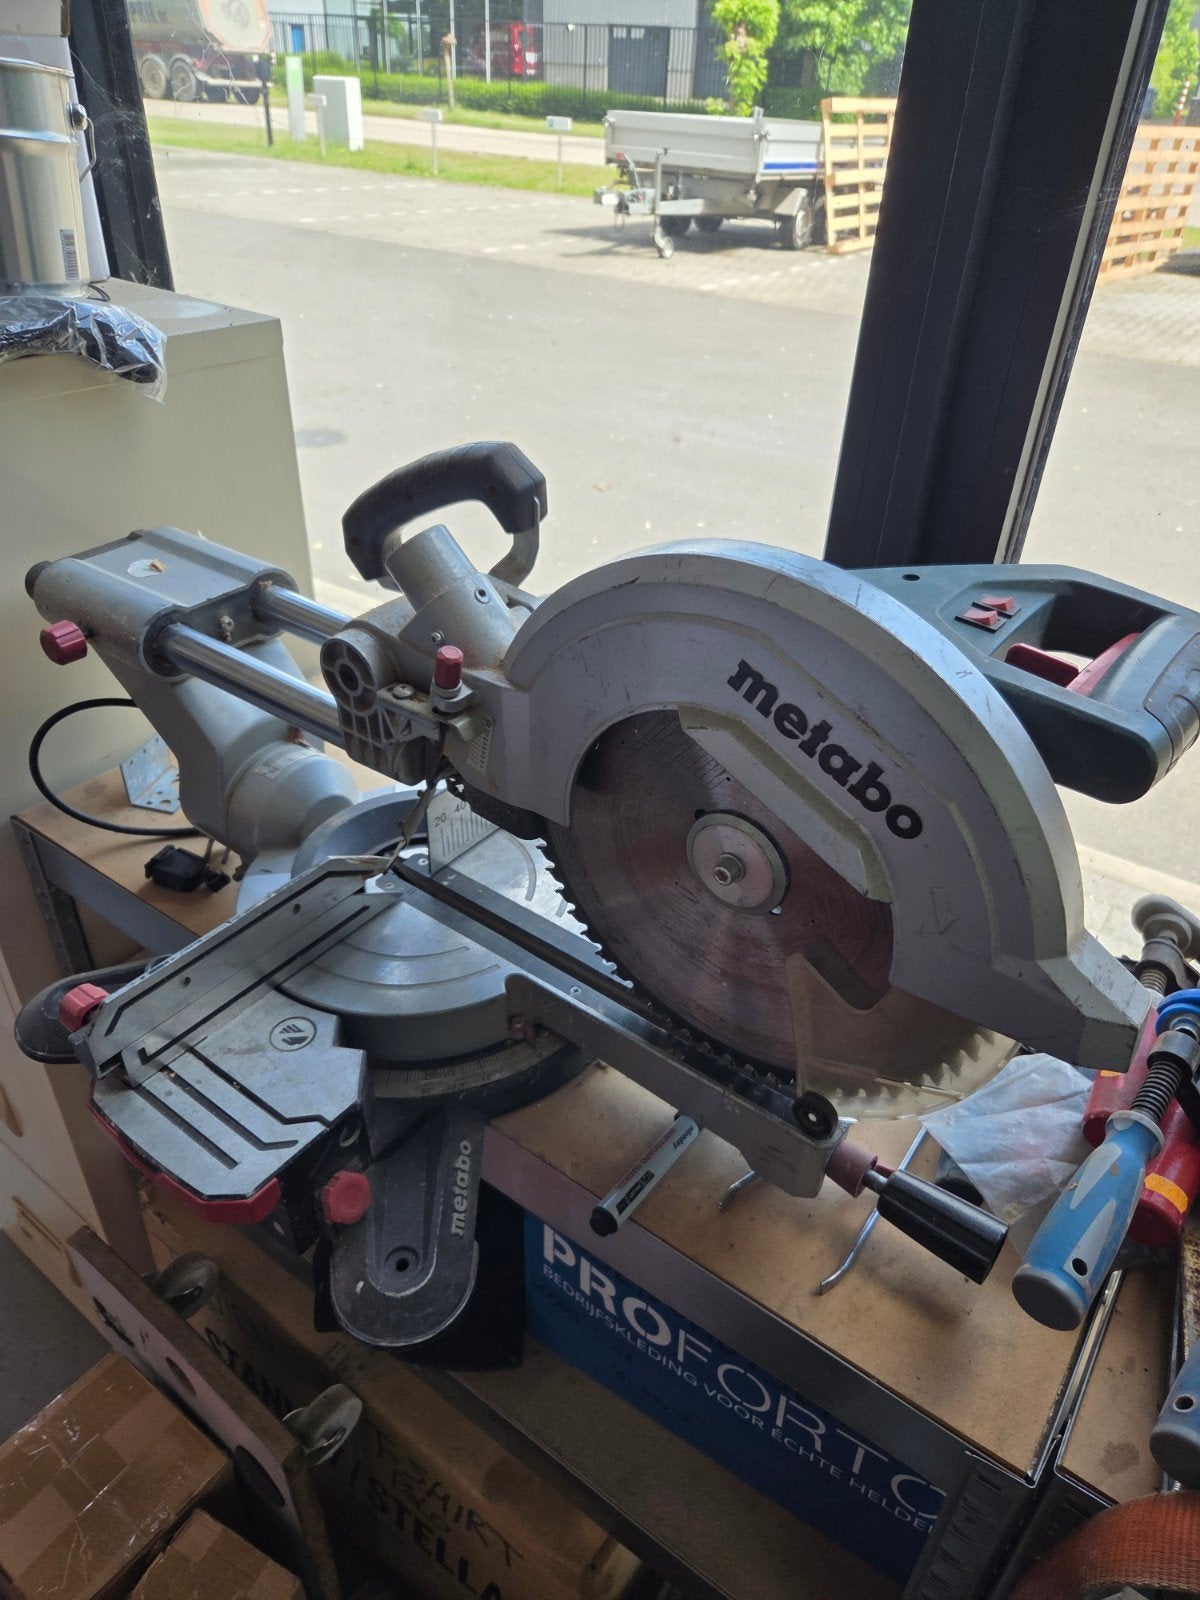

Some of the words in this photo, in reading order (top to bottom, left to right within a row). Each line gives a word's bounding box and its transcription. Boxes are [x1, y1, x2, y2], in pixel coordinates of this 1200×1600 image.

[434, 813, 447, 827] 20
[454, 800, 468, 813] 40
[727, 659, 923, 839] metabo
[451, 1140, 472, 1236] metabo
[543, 1264, 698, 1386] BEDRIJFSKLEDING
[703, 1382, 764, 1430] VOOR
[771, 1427, 842, 1479] ÉCHTE
[849, 1477, 933, 1533] HELDE
